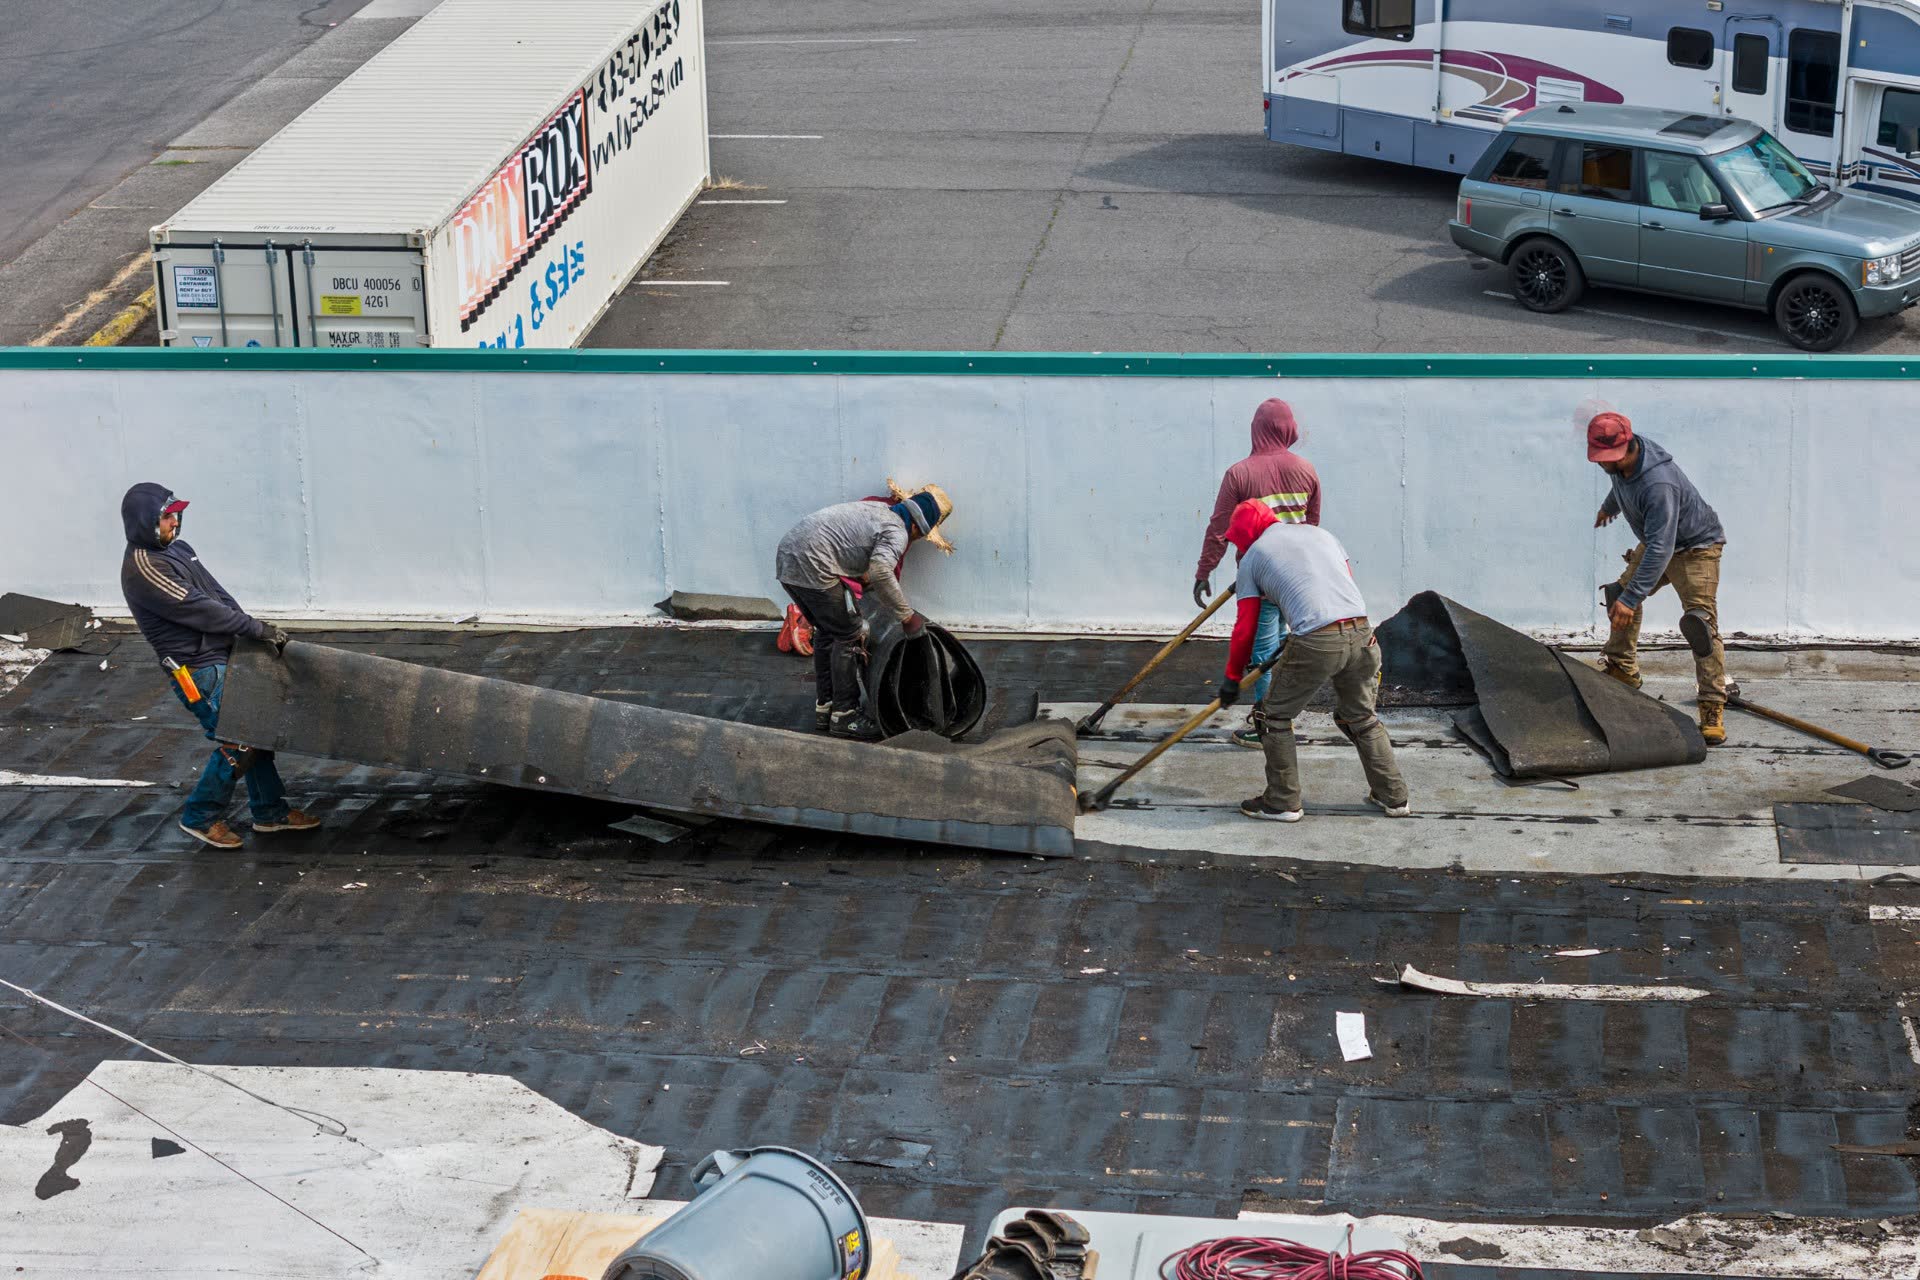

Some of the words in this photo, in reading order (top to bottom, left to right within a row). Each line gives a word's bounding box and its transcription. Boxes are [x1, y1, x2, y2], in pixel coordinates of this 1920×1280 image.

[333, 277, 359, 290] DBCU
[363, 278, 401, 291] 400056
[364, 295, 389, 308] 42G1
[806, 1170, 844, 1206] BRUTE
